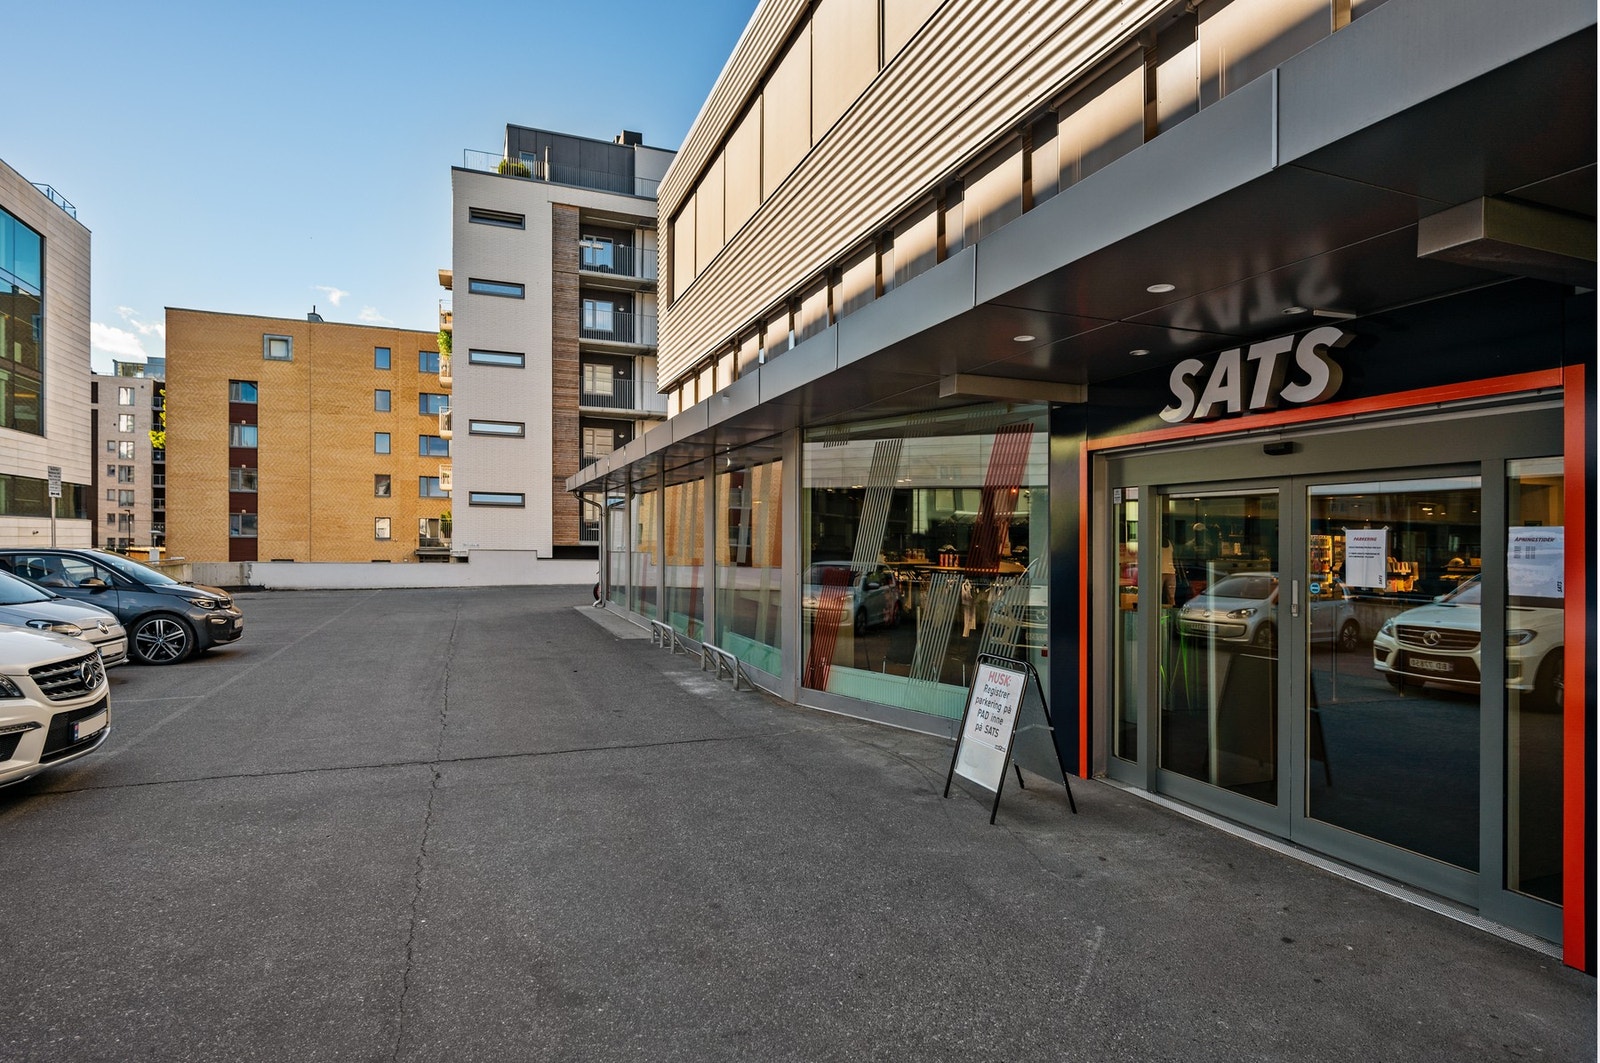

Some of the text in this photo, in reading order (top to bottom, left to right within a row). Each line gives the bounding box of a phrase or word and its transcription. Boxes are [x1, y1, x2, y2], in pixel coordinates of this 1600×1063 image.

[1159, 326, 1345, 423] SATS
[988, 671, 1012, 687] HUSK:
[984, 684, 1010, 700] Registrer
[975, 696, 1012, 716] parkering på
[977, 709, 1003, 726] PAD inne
[975, 723, 999, 738] på SATS
